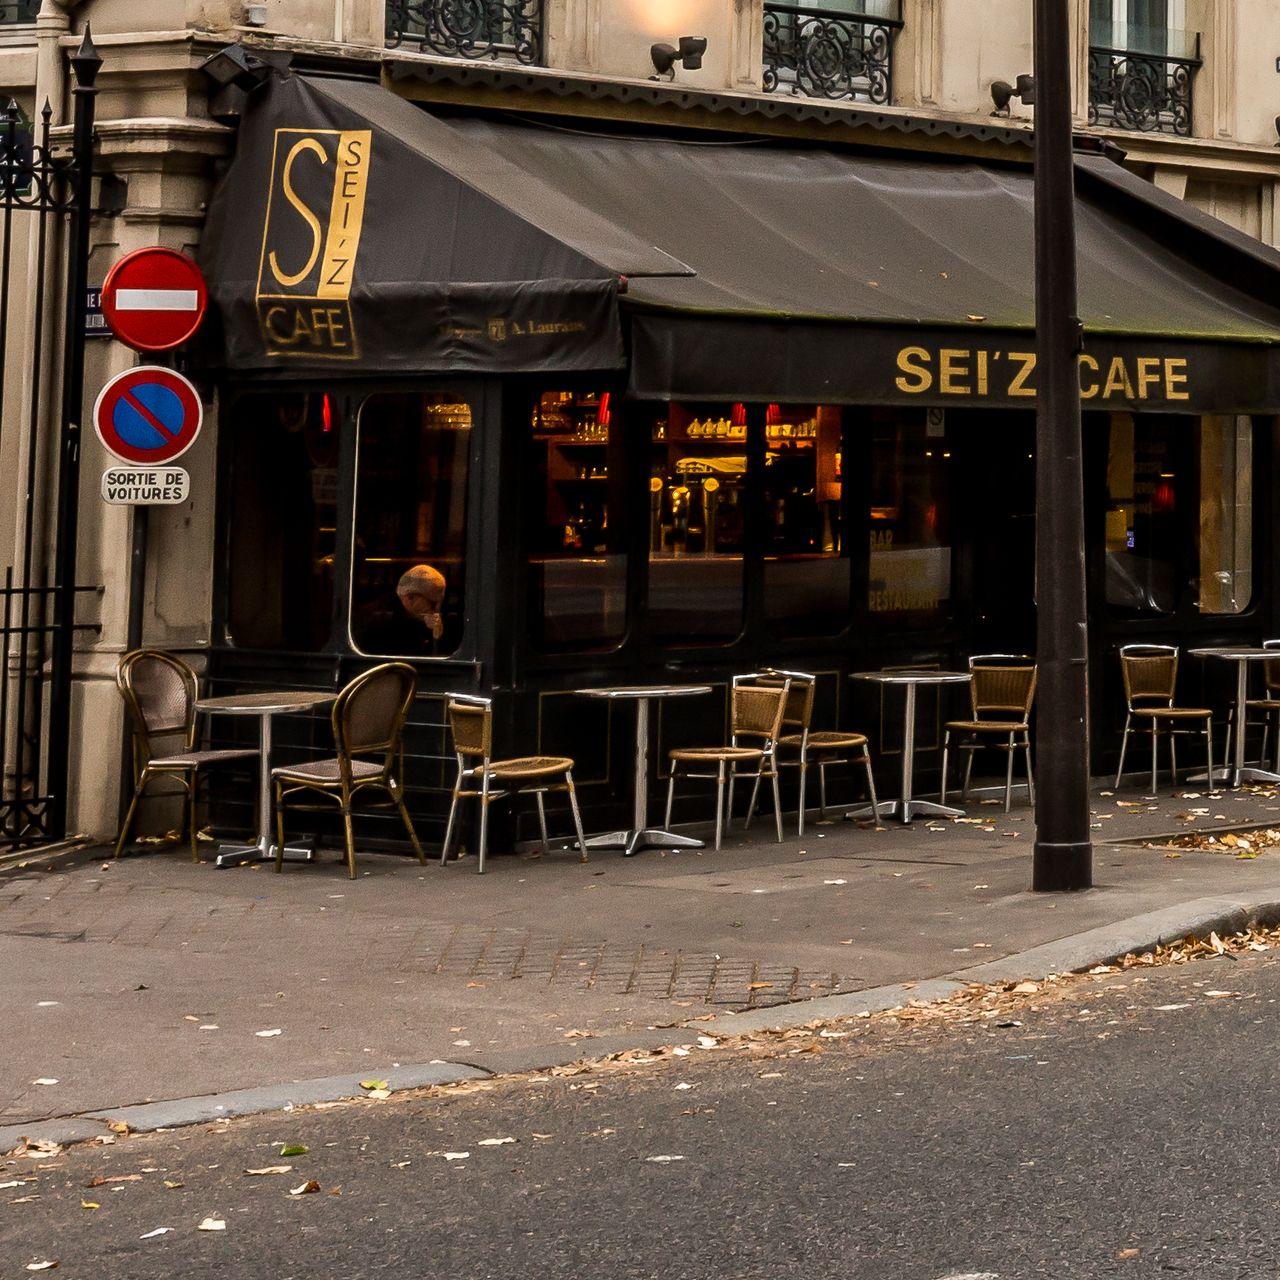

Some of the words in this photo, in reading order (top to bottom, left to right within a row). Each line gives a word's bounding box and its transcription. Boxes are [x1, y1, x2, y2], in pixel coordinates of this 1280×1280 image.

[266, 306, 347, 348] CAFE
[895, 346, 1037, 397] SEI'Z
[1078, 354, 1190, 401] CAFE
[107, 473, 157, 485] SORTIE
[165, 473, 184, 485] DE
[107, 487, 183, 499] VOITURES
